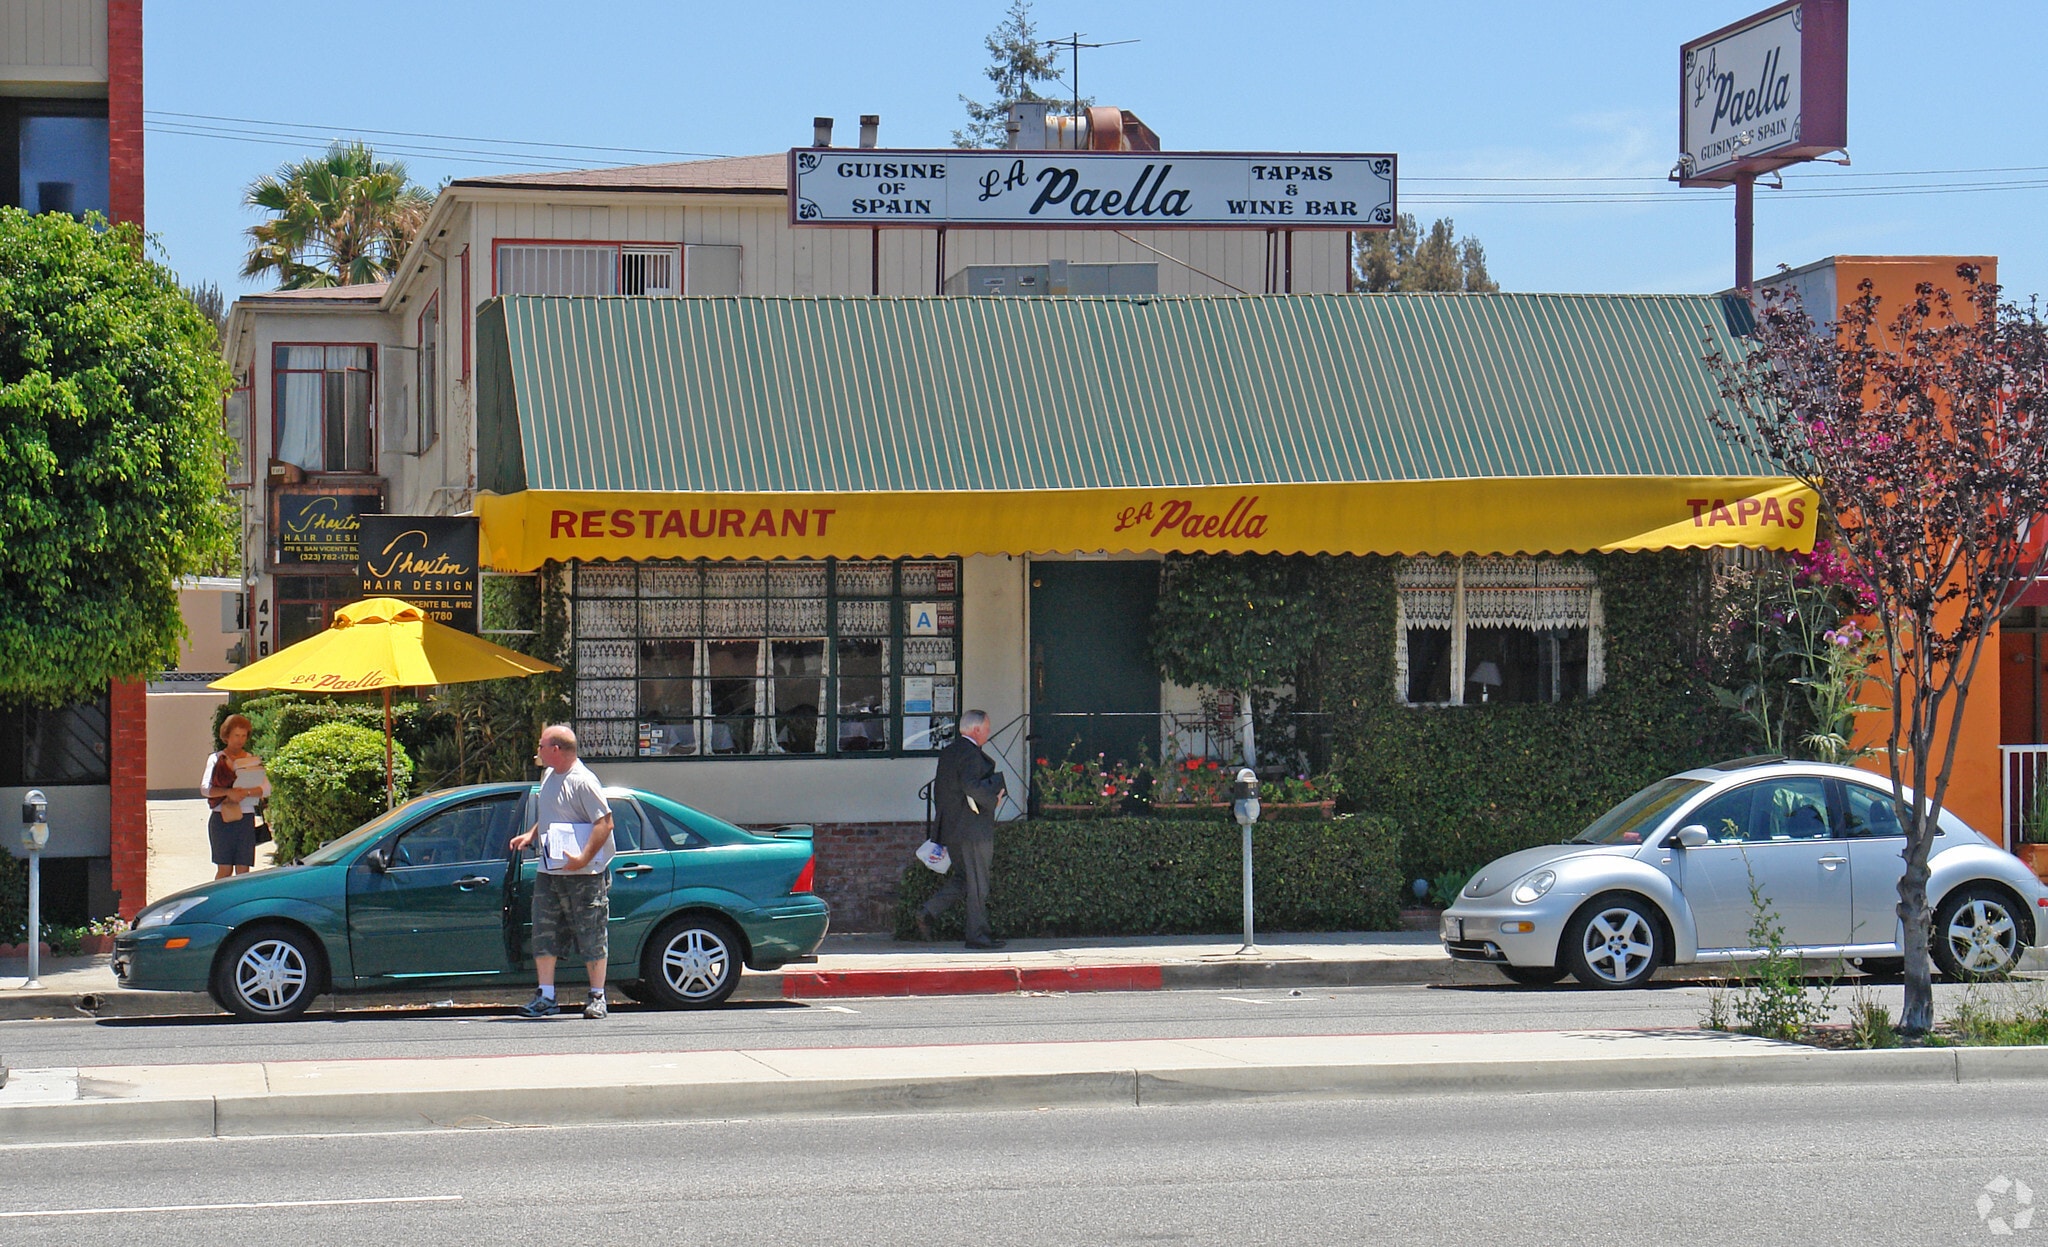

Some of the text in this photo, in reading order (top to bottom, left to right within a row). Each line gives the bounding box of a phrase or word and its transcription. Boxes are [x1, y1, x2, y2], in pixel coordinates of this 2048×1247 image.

[1694, 46, 1790, 134] LA Paella
[1757, 117, 1787, 142] SPAIN
[1251, 165, 1333, 181] TAPAS
[878, 182, 906, 195] OF
[978, 159, 1193, 216] LA Paella
[1285, 184, 1298, 196] &
[852, 198, 931, 214] SPAIN
[1227, 200, 1358, 216] WINE BAR
[287, 496, 360, 532] Thaxto
[1114, 496, 1268, 538] LA Paella
[1686, 497, 1806, 529] TAPAS
[550, 509, 836, 538] RESTAURANT
[300, 553, 320, 561] (323)
[363, 580, 472, 591] HAIR DESIGN
[259, 599, 268, 656] 478
[916, 612, 931, 628] A
[290, 669, 385, 689] LA Paella
